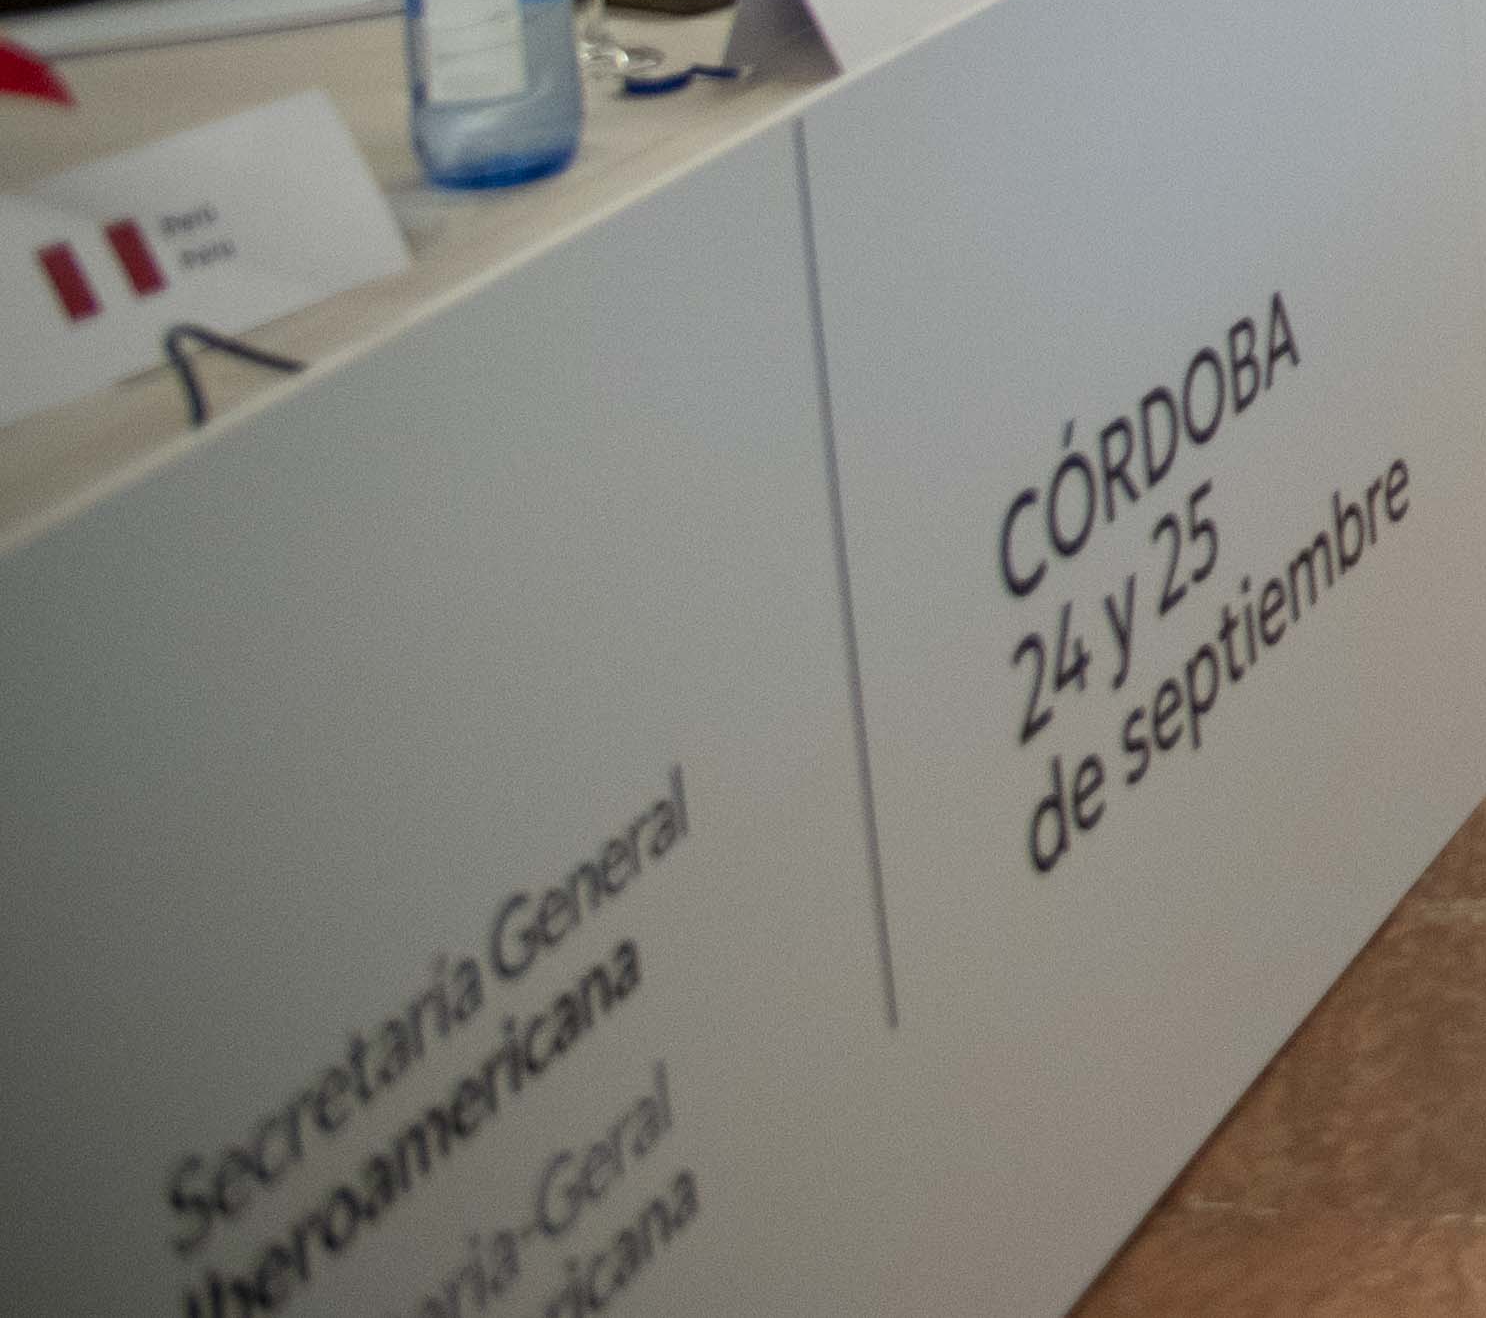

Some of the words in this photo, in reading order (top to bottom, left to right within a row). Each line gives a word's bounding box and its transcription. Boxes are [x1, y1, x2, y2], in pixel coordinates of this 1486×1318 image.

[999, 291, 1301, 597] CÓRDOBA
[1011, 600, 1093, 745] 24
[1104, 574, 1137, 691] y
[1151, 478, 1219, 617] 25
[1028, 753, 1106, 875] de
[1123, 458, 1410, 786] septiembre
[490, 763, 689, 981] General
